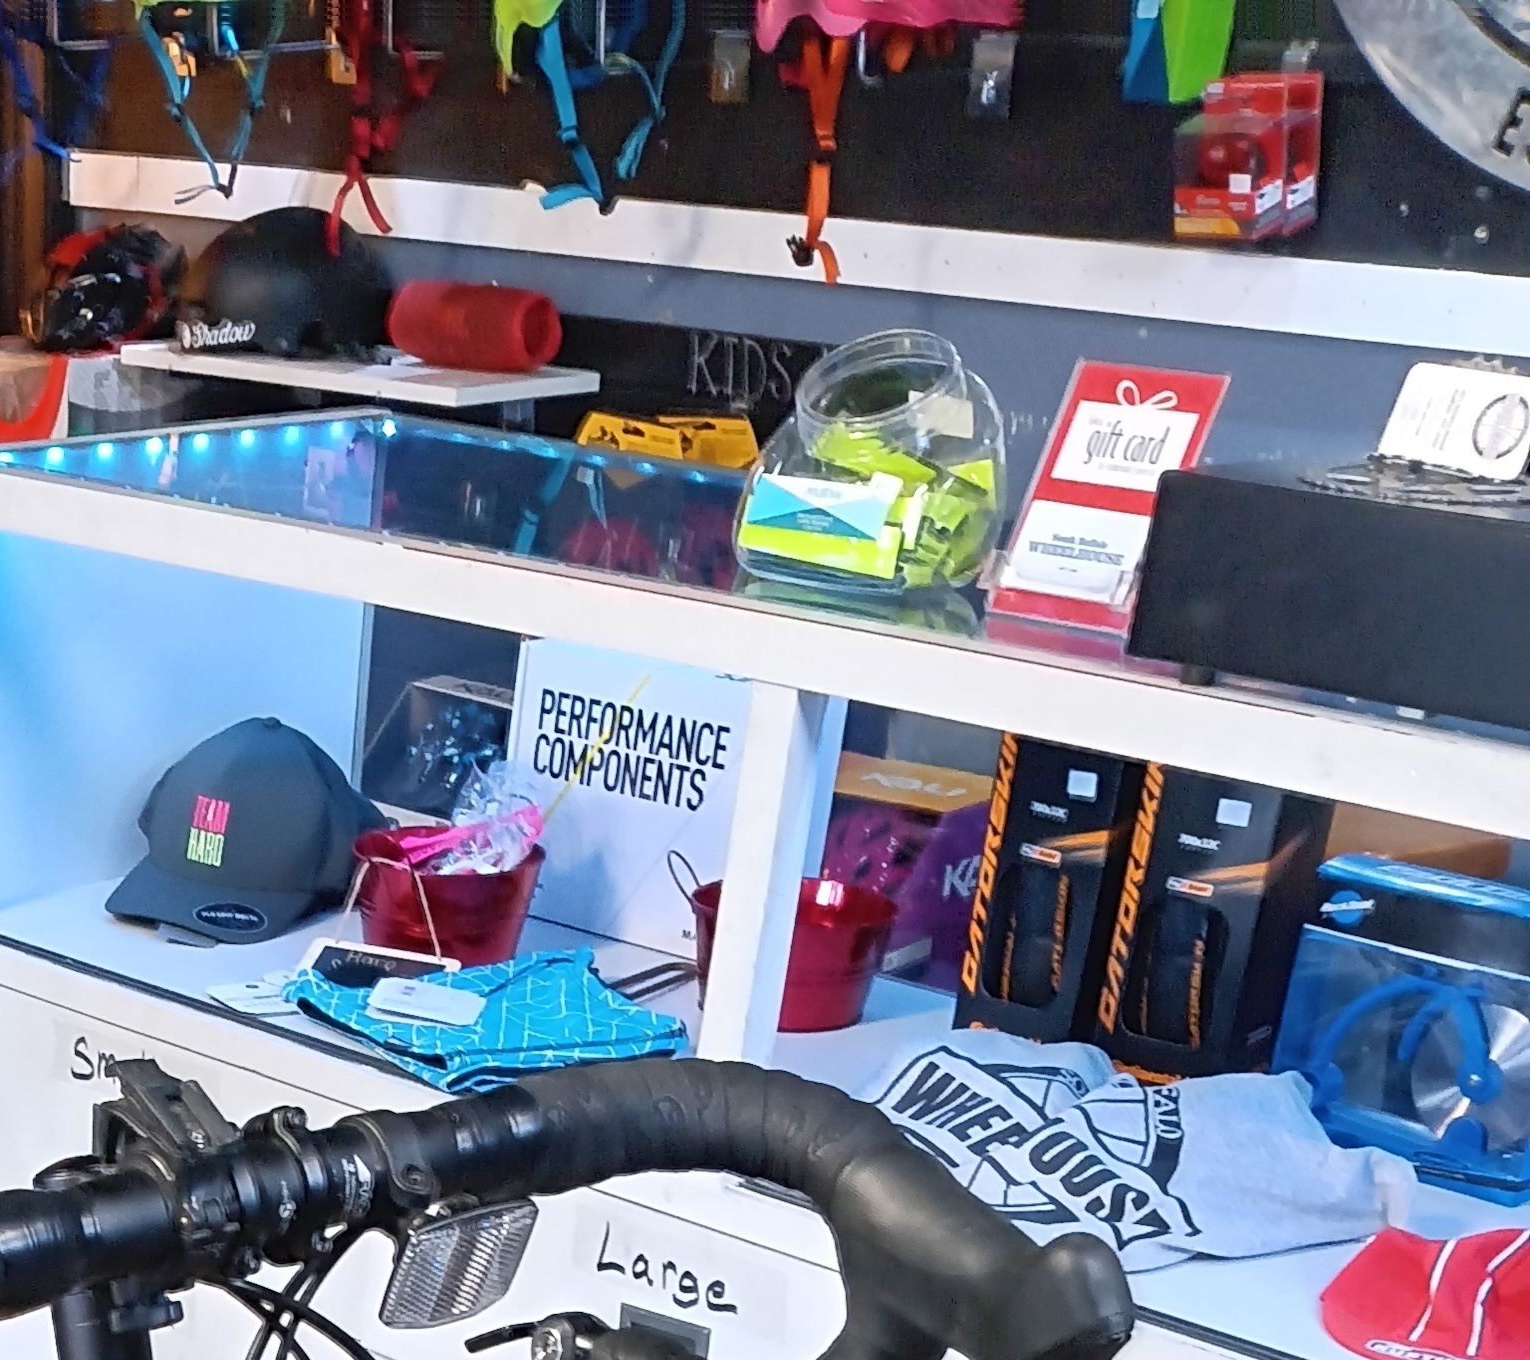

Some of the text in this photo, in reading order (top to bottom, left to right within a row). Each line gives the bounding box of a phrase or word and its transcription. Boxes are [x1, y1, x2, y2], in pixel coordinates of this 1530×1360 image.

[686, 333, 793, 403] KIDS
[1084, 419, 1172, 465] gift card
[537, 687, 732, 771] PERFORMANCE
[532, 733, 708, 813] COMPONENTS
[186, 827, 225, 868] HARO
[191, 795, 231, 834] TEAM
[595, 1220, 739, 1316] Large
